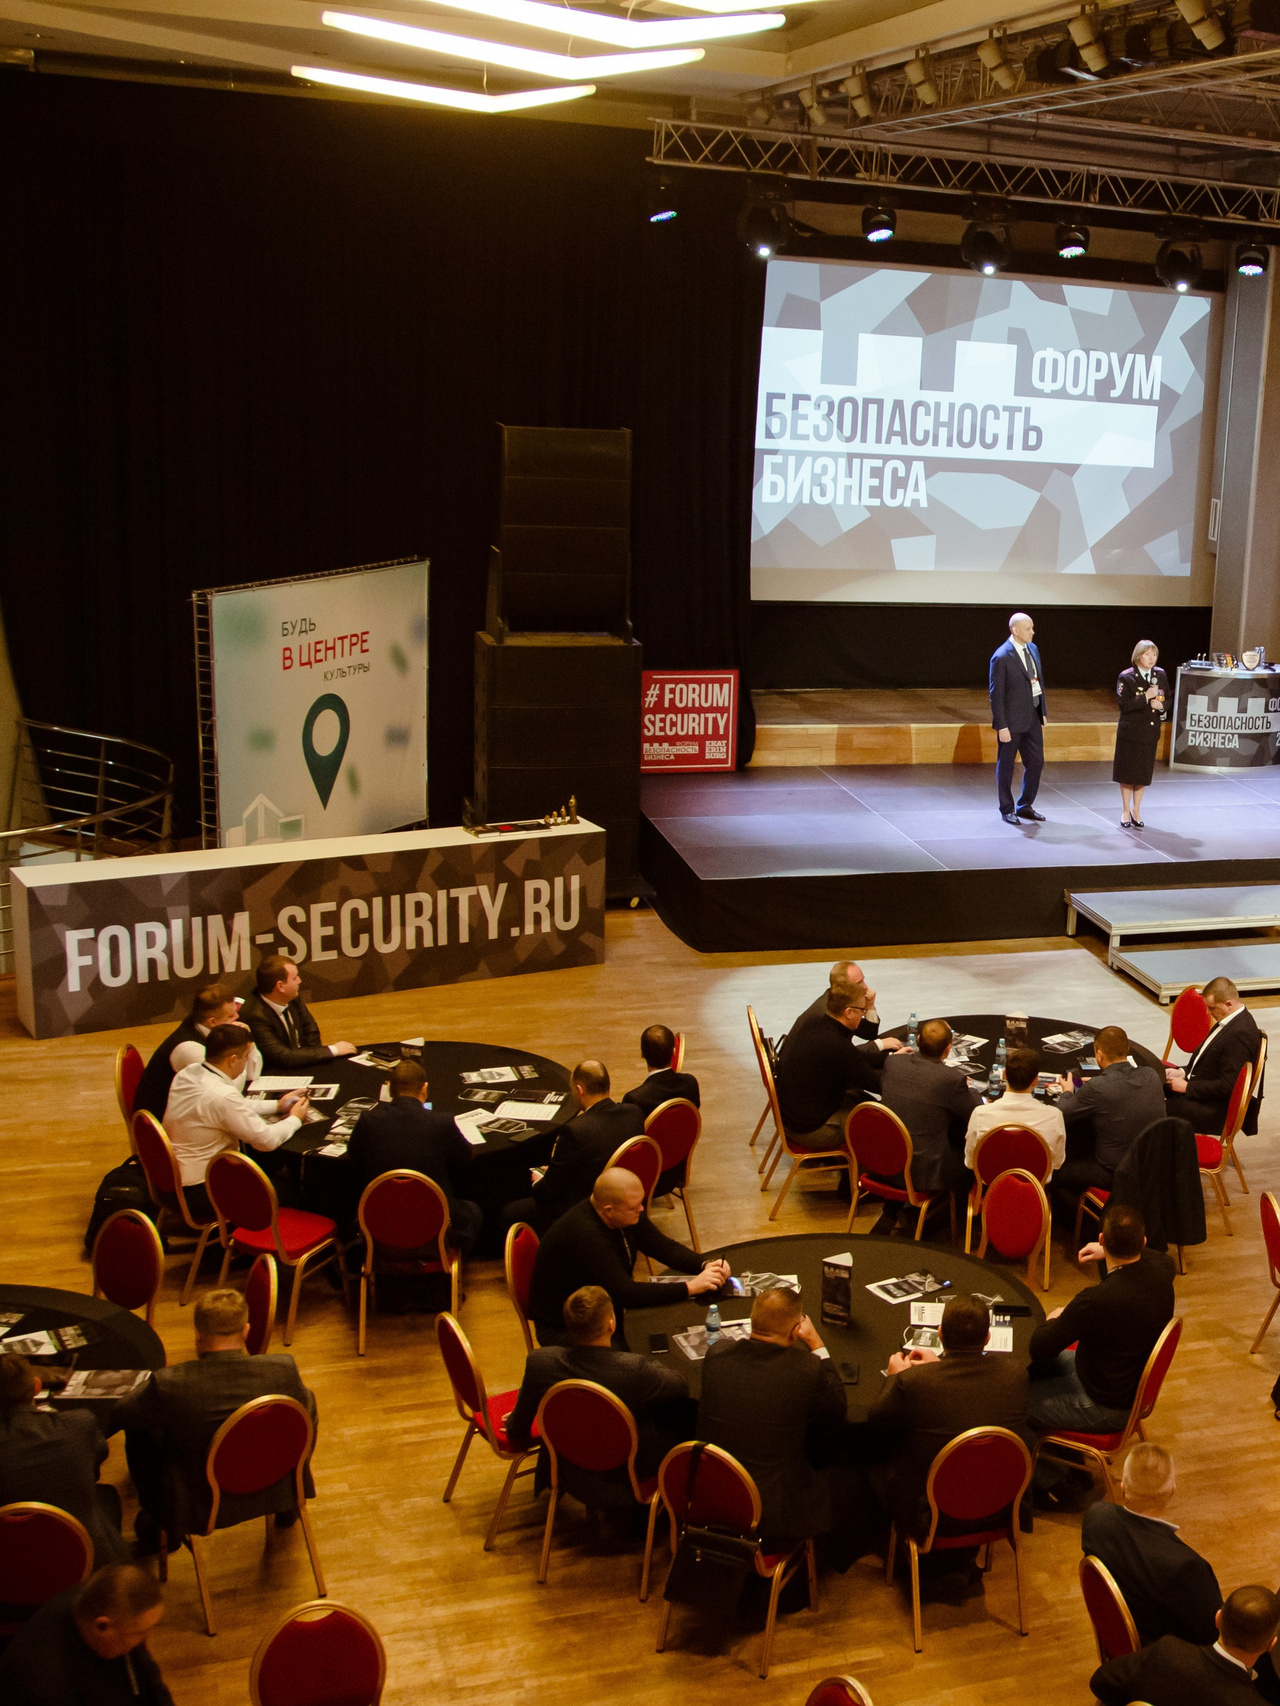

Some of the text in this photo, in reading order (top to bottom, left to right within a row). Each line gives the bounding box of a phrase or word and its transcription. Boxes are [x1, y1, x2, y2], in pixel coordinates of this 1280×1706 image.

[1031, 346, 1163, 400] ФОРУМ
[764, 392, 1043, 452] БЕЗОПАСНОСТЬ
[761, 455, 929, 508] БИЗНЕСА
[282, 618, 316, 637] БУДЬ
[282, 631, 370, 670] В ЦЕНТРЕ
[324, 662, 370, 682] КУЛЬТУРЫ
[664, 683, 730, 708] FORUM
[644, 713, 728, 736] SECURITY
[1190, 714, 1272, 730] БЕЗОПАСНОСТЬ
[1188, 731, 1239, 748] БИЗНЕСА
[64, 874, 581, 993] FORUM-SECURITY.RU
